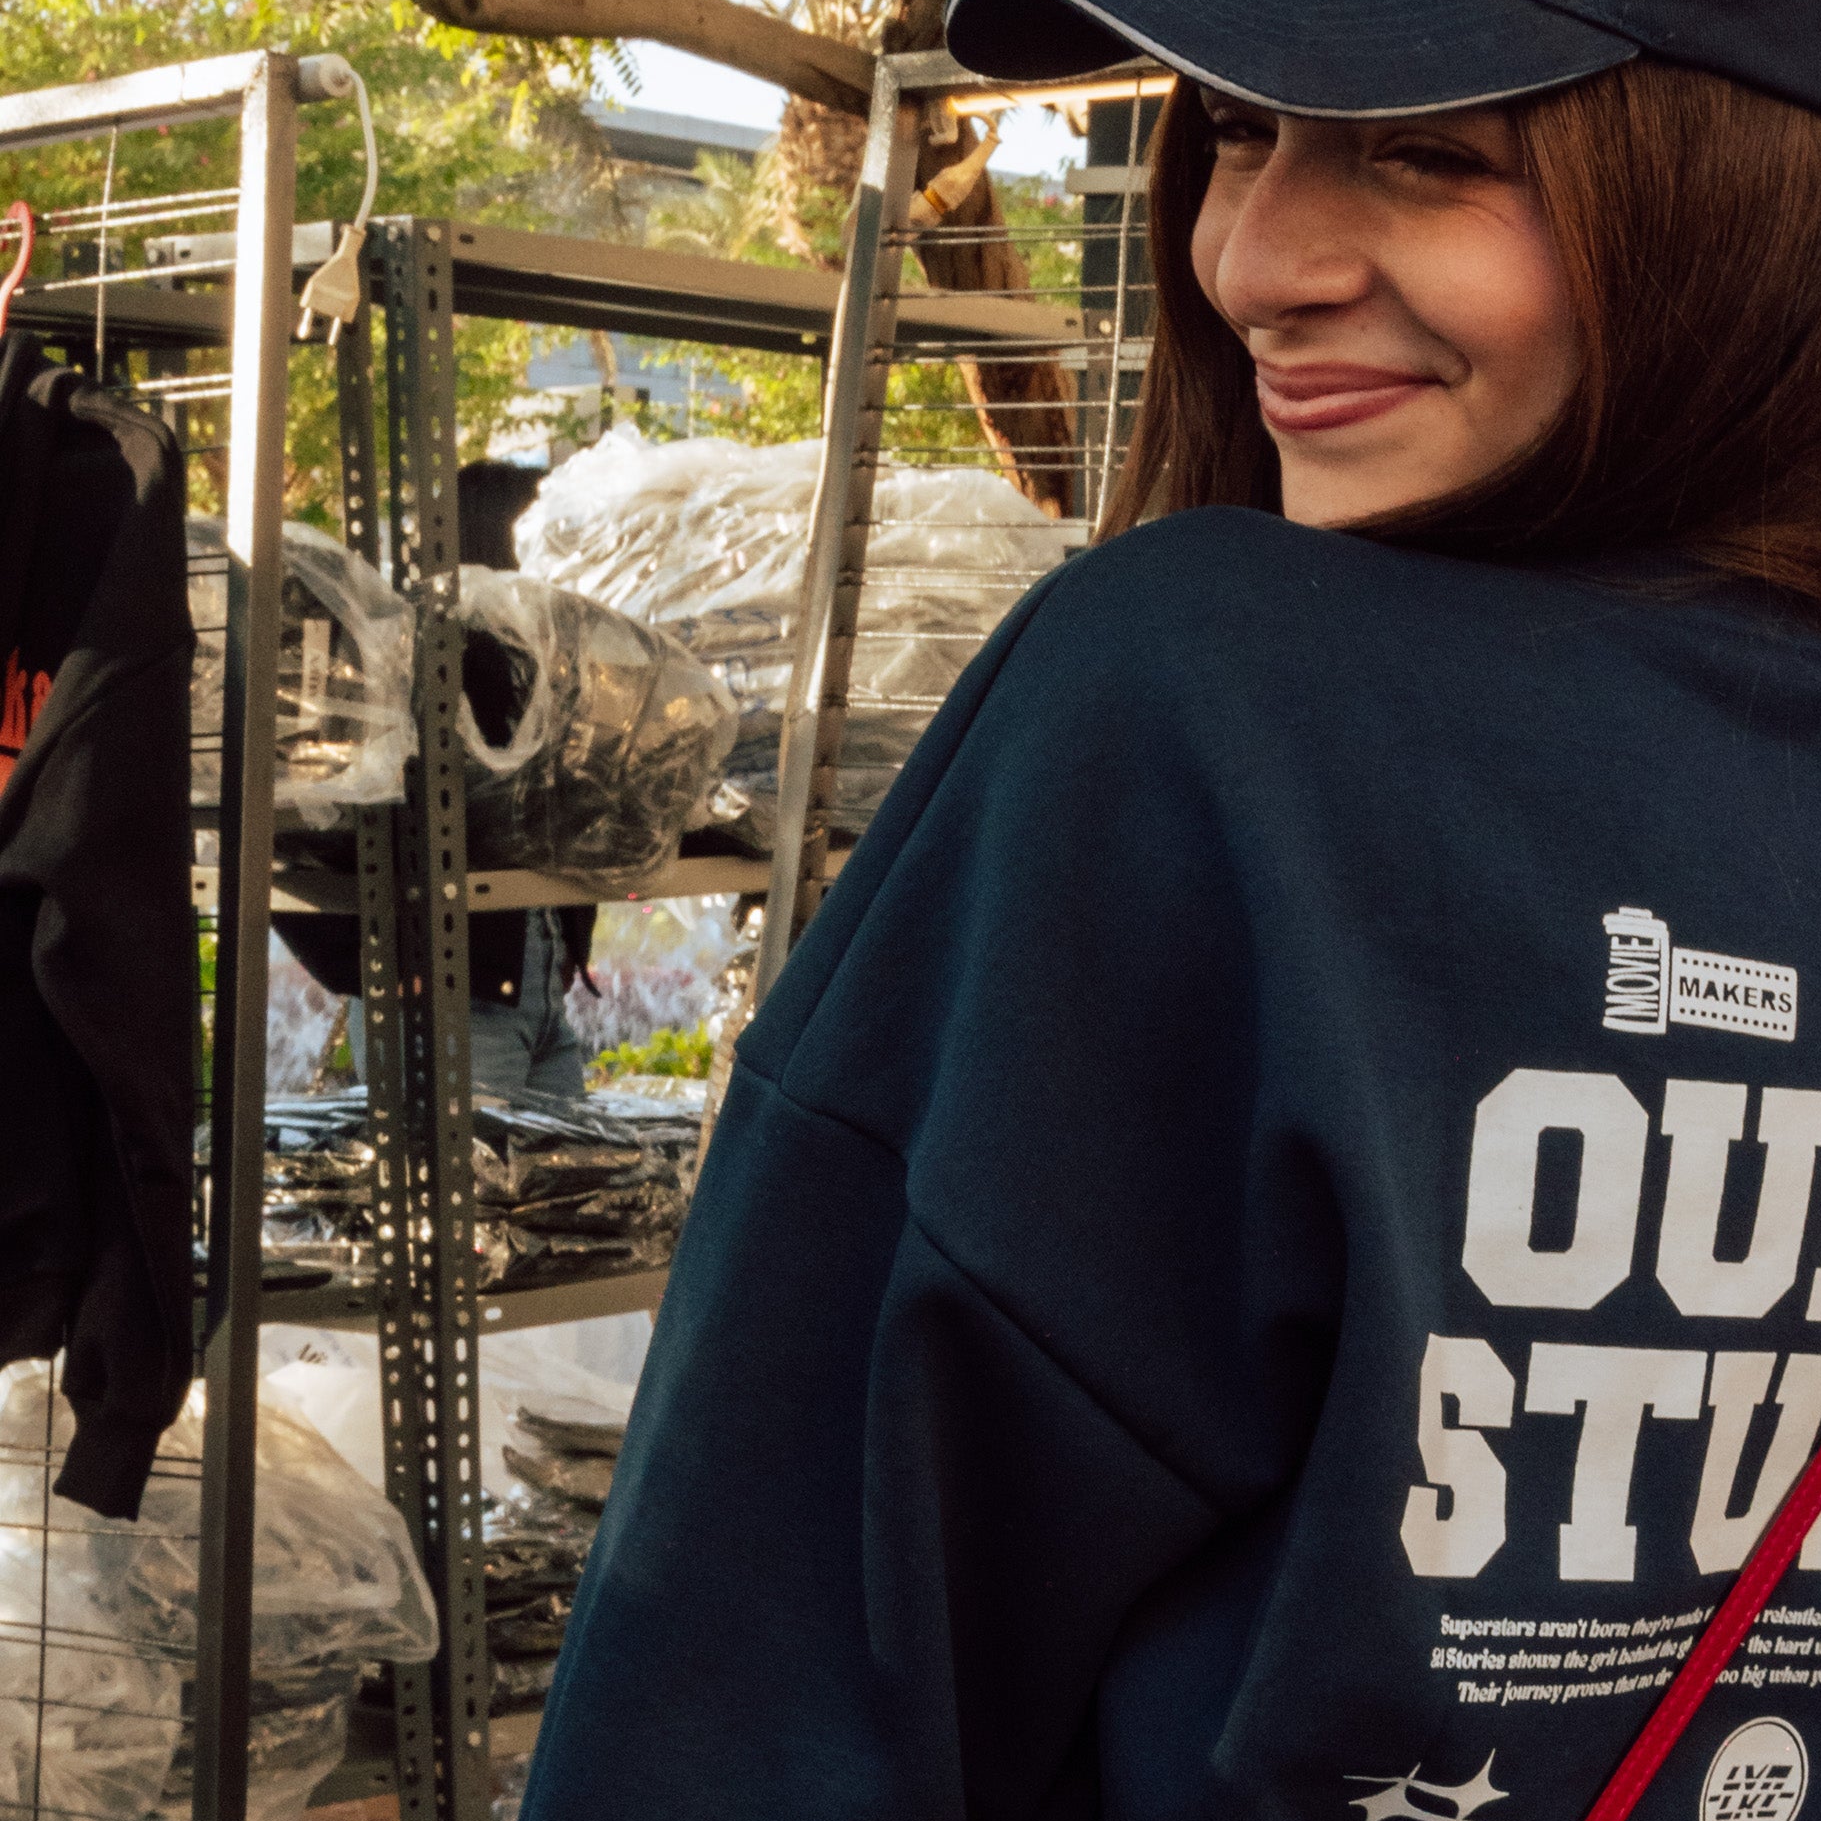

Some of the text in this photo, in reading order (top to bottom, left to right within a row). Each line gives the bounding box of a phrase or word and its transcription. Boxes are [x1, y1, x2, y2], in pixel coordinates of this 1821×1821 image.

[1602, 935, 1661, 1033] MOVIE
[1679, 975, 1793, 1014] MAKERS
[1441, 1614, 1536, 1640] Superstars
[1538, 1618, 1588, 1637] aren't
[1747, 1634, 1773, 1655] the
[1773, 1636, 1815, 1655] hard
[1445, 1647, 1507, 1670] Stories
[1507, 1649, 1561, 1669] shows
[1563, 1650, 1588, 1669] the
[1714, 1668, 1740, 1684] oo
[1741, 1665, 1769, 1689] big
[1769, 1665, 1810, 1684] when
[1458, 1681, 1503, 1703] Their
[1500, 1680, 1564, 1707] journey
